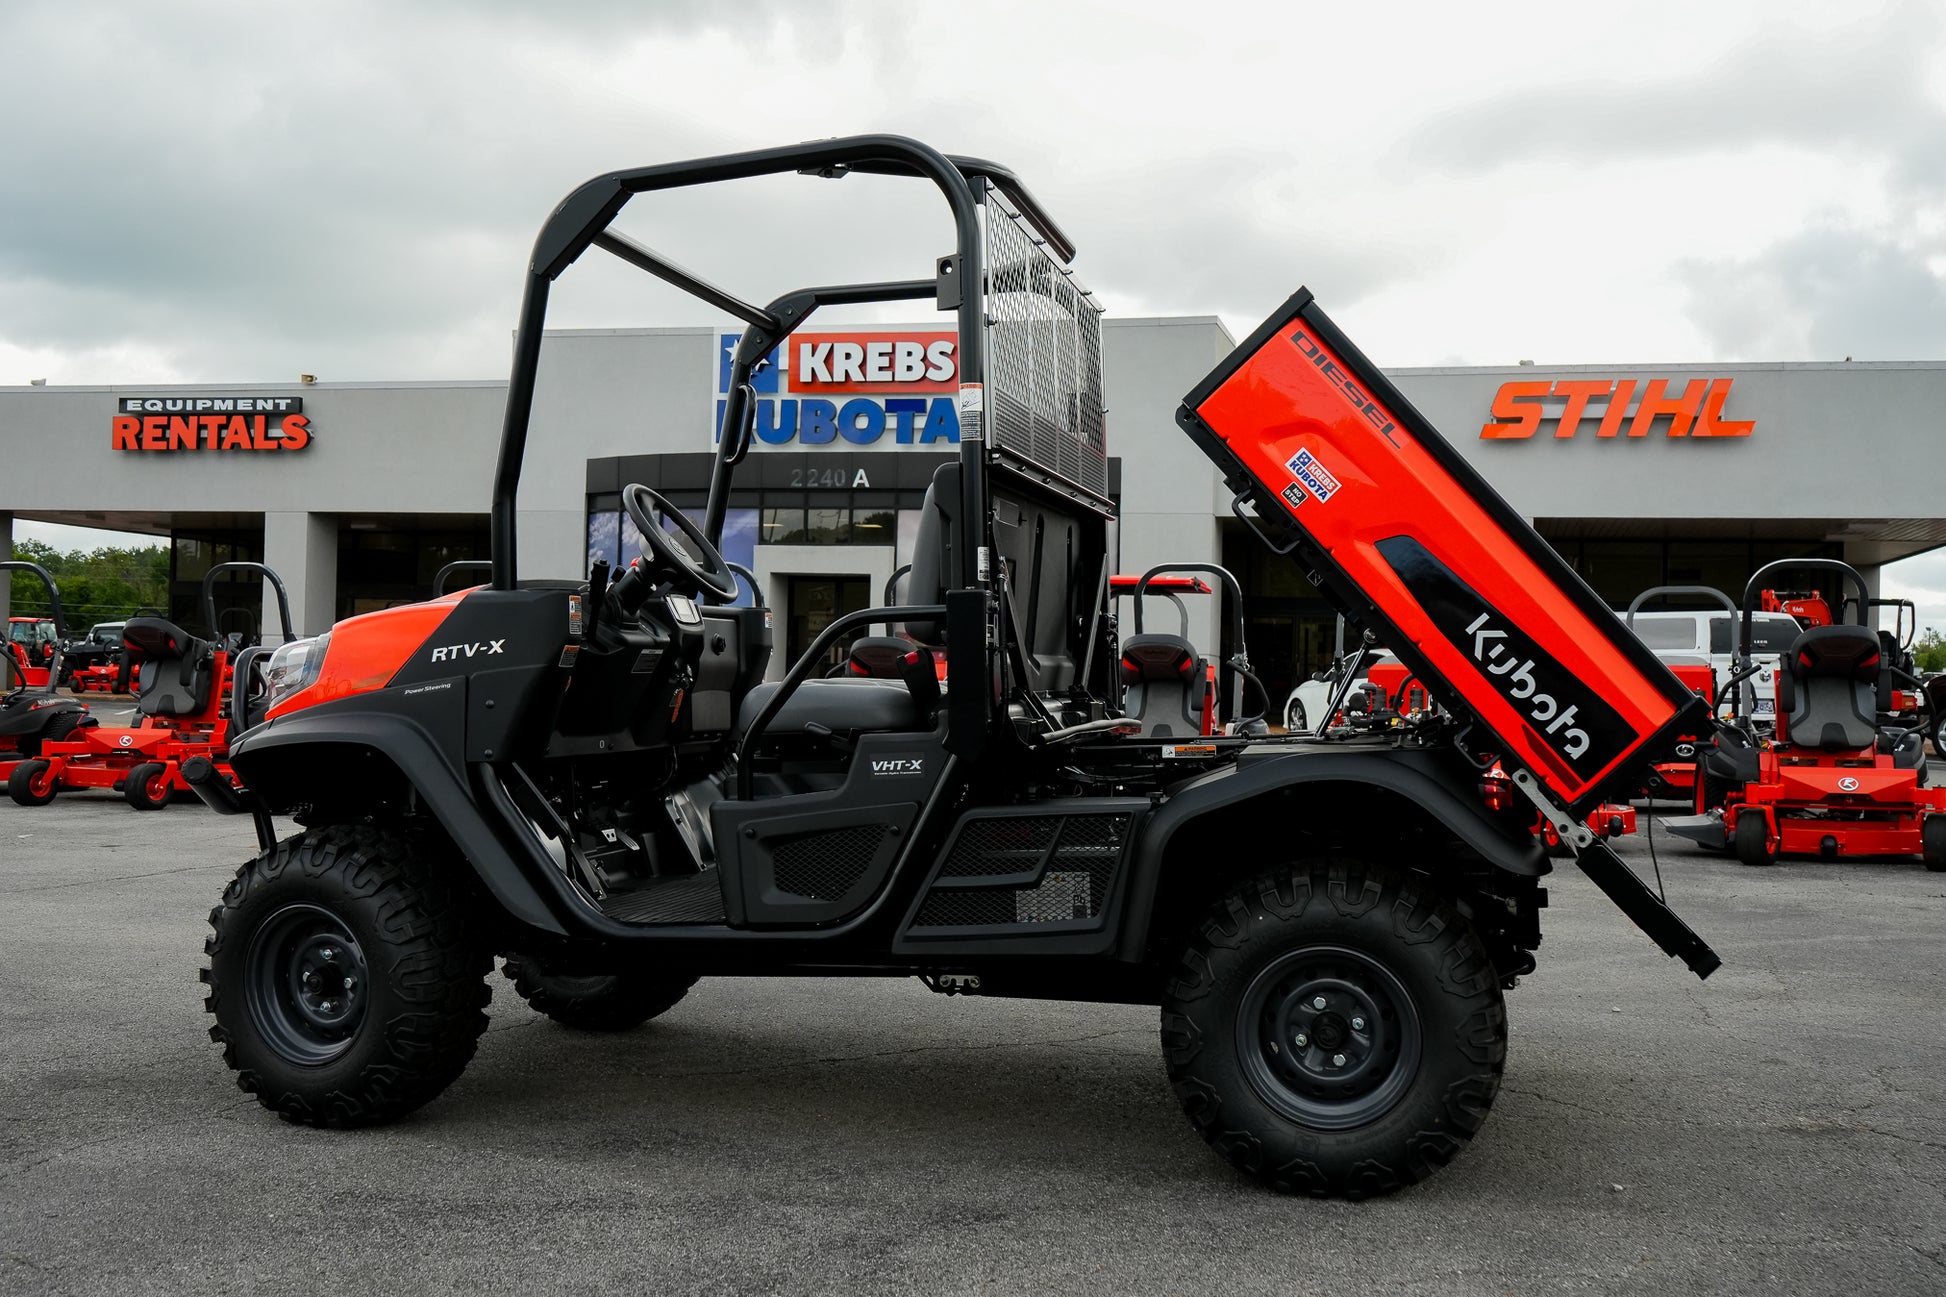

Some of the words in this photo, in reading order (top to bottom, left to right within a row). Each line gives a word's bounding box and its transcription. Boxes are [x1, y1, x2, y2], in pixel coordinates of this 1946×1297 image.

[800, 340, 956, 383] KREBS
[1290, 330, 1401, 449] DIESEL
[126, 399, 292, 411] EQUIPMENT
[1480, 378, 1756, 440] STIHL
[112, 413, 310, 450] RENTALS
[790, 468, 847, 487] 2240
[852, 468, 870, 488] A
[1289, 460, 1329, 500] KUBOTA
[1308, 463, 1335, 490] KREBS
[1284, 489, 1300, 505] STEP
[1292, 487, 1303, 498] NO
[431, 638, 506, 662] RTV-X
[1465, 612, 1591, 760] Kubota
[872, 759, 923, 771] VHT-X
